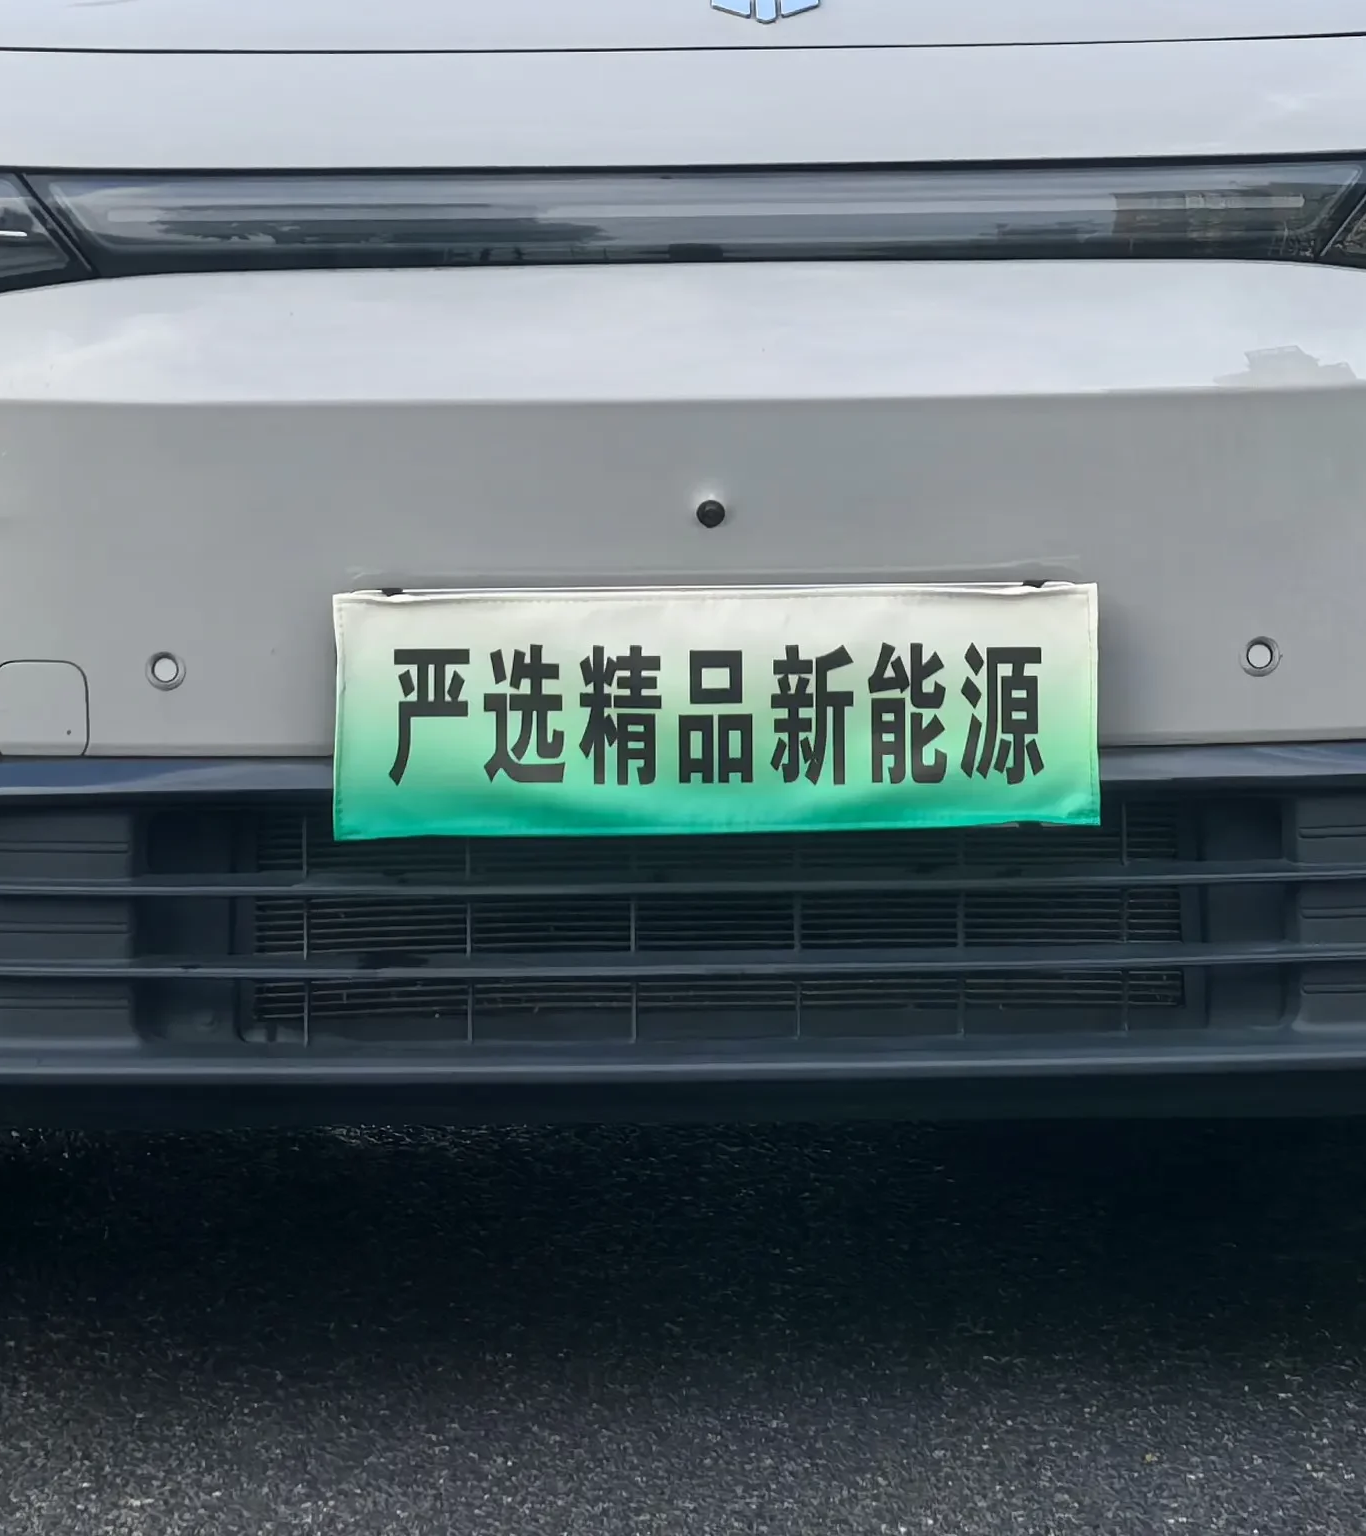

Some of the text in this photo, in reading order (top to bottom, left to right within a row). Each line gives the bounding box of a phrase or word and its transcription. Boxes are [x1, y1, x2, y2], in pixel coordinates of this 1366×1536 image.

[388, 643, 1045, 786] 严选精品新能源
